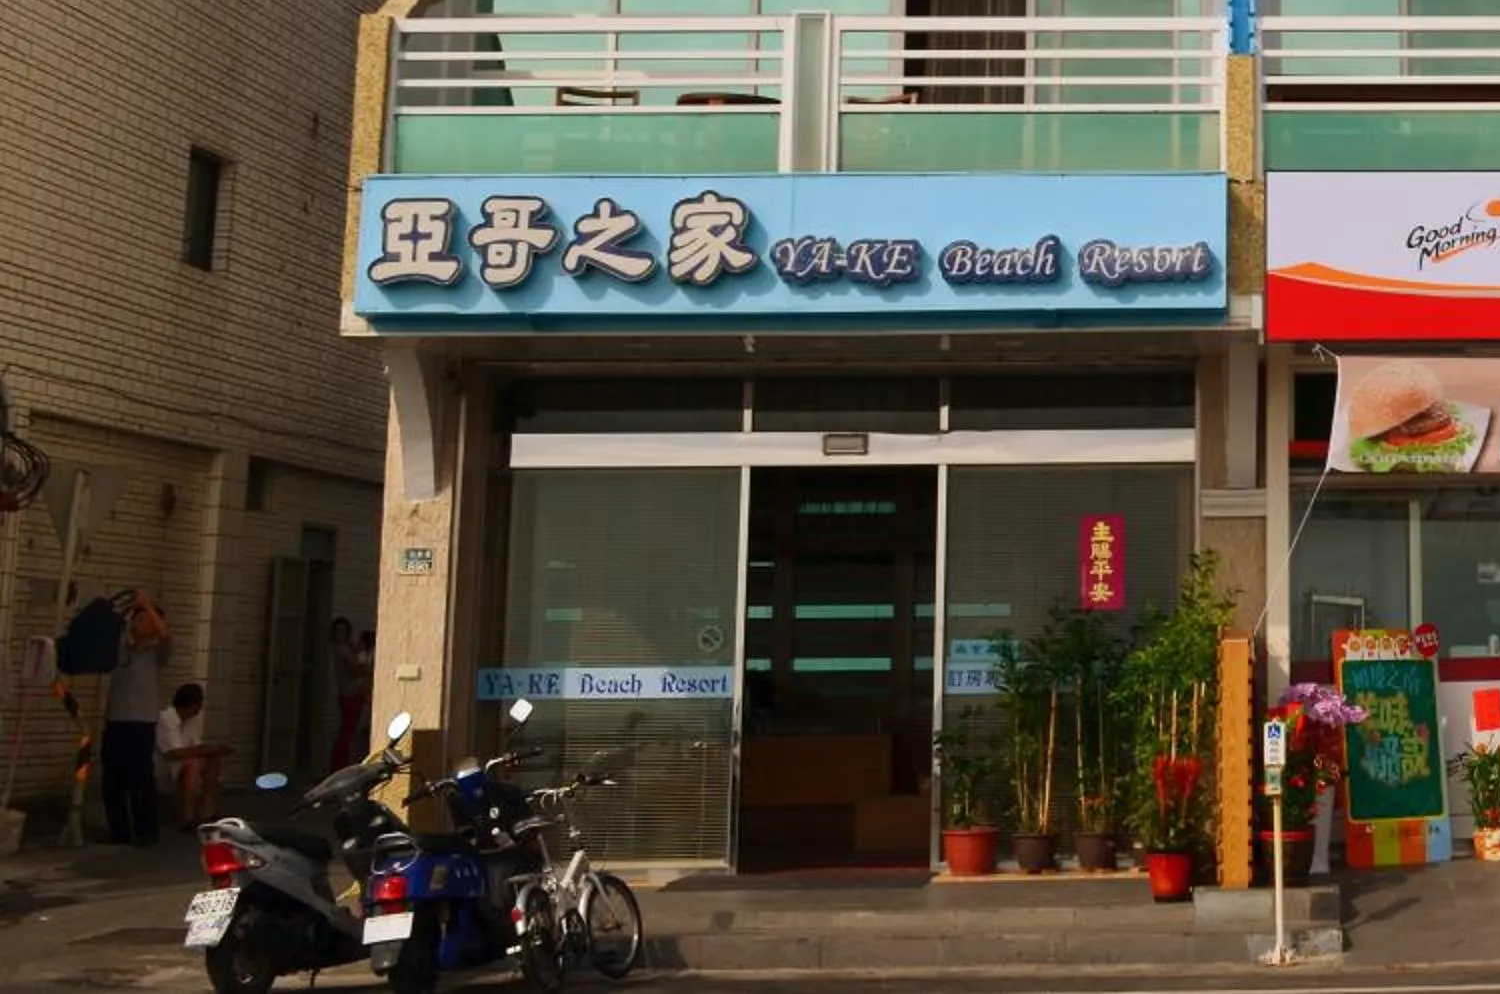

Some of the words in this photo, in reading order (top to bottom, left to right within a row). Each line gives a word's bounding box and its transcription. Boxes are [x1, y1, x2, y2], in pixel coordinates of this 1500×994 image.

[368, 190, 757, 287] 亞哥之家
[1406, 215, 1463, 250] Good
[1419, 227, 1498, 270] Morning
[941, 236, 1056, 282] Beach
[1078, 239, 1213, 283] Resort
[579, 673, 642, 696] Beach
[661, 673, 728, 694] Resort
